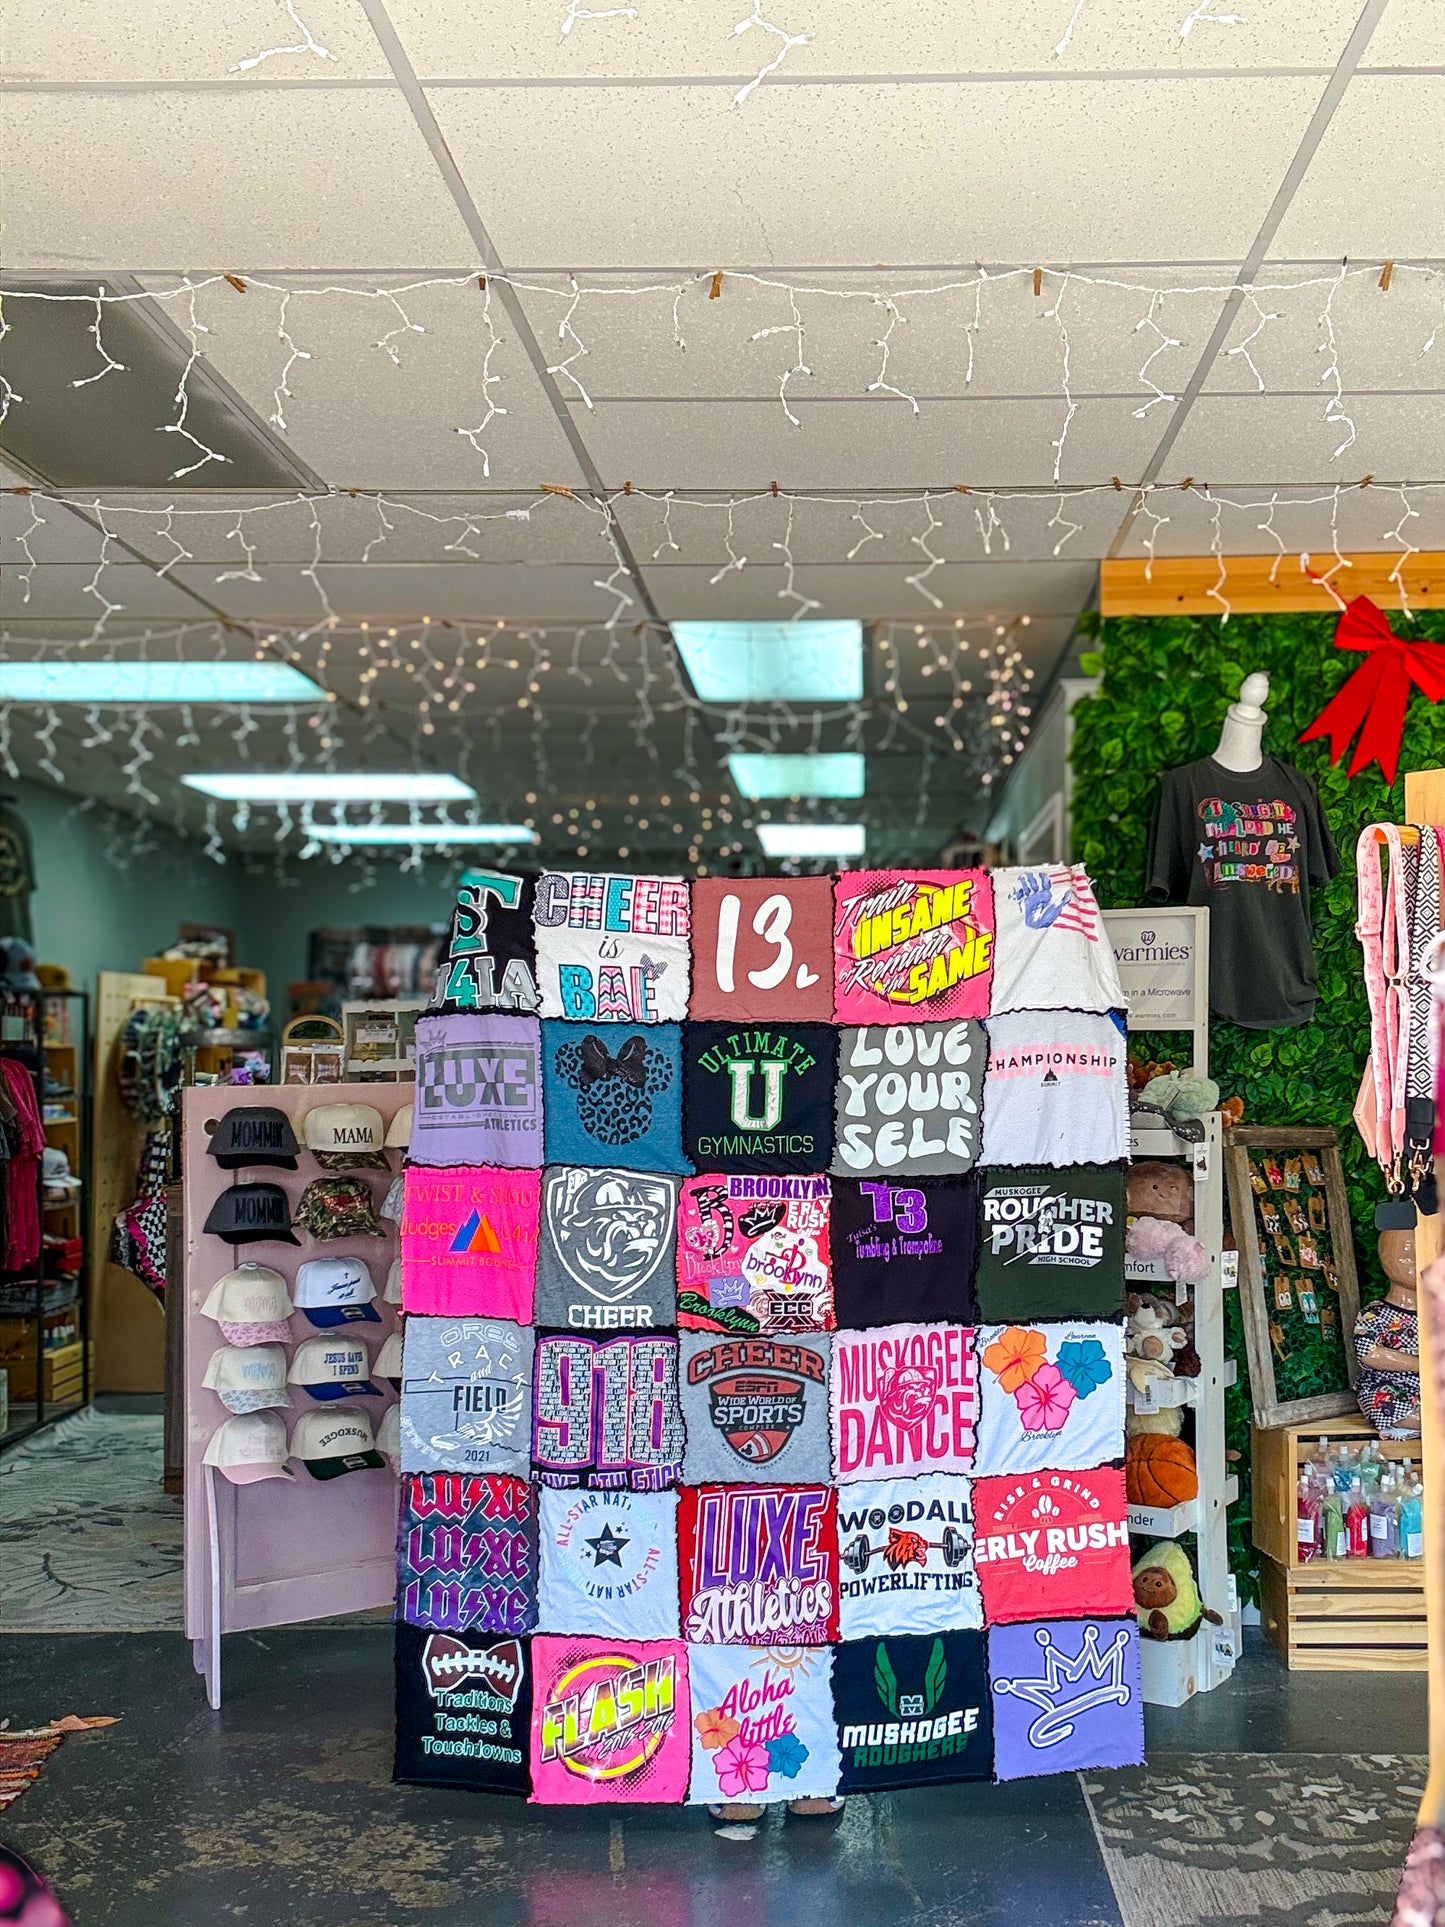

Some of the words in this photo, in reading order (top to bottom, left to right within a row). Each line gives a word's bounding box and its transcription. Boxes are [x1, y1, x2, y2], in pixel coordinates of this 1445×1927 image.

[1277, 823, 1294, 834] HE
[534, 874, 690, 936] CHEER
[835, 879, 917, 936] Train
[860, 879, 973, 959] INSANE
[598, 935, 624, 959] is
[844, 930, 952, 996] Remain
[909, 931, 993, 1004] SAME
[1148, 988, 1191, 997] Microwave
[697, 1031, 816, 1076] ULTIMATE
[850, 1022, 972, 1067] LOVE
[420, 1049, 534, 1108] LUXE
[727, 1059, 788, 1131] U
[841, 1071, 977, 1117] YOUR
[333, 1127, 373, 1144] MAMA
[484, 1117, 537, 1131] ATHLETICS
[698, 1135, 814, 1159] GYMNASTICS
[838, 1117, 973, 1170] SELF
[404, 1184, 464, 1202] TWIST
[994, 1187, 1042, 1196] MUSKOGEE
[983, 1196, 1114, 1225] ROUGHER
[400, 1217, 456, 1240] Judges
[991, 1223, 1104, 1257] PRIDE
[431, 1256, 479, 1267] SUMMIT
[892, 1237, 898, 1255] &
[1058, 1257, 1092, 1266] SCHOOL
[568, 1305, 654, 1328] CHEER
[428, 1344, 528, 1390] TRACK
[687, 1340, 825, 1386] CHEER
[839, 1329, 974, 1405] MUSKOGEE
[453, 1385, 507, 1413] FIELD
[535, 1335, 681, 1470] 918
[717, 1396, 747, 1406] WIDE
[747, 1396, 784, 1405] WORLD
[735, 1381, 779, 1392] ESPN
[713, 1404, 803, 1425] SPORTS
[319, 1426, 368, 1448] MUSKOGEE
[839, 1392, 975, 1472] DANCE
[464, 1450, 490, 1462] 2021
[993, 1488, 1026, 1522] RISE
[1032, 1477, 1042, 1488] &
[1050, 1475, 1101, 1509] GRIND
[839, 1499, 974, 1533] WOODALL
[698, 1489, 828, 1589] LUXE
[974, 1529, 1041, 1563] ERLY
[1046, 1520, 1129, 1554] RUSH
[1022, 1553, 1079, 1576] Coffee
[840, 1570, 973, 1600] POWERLIFTING
[685, 1576, 832, 1643] Athletics
[435, 1688, 514, 1715] Traditions
[541, 1655, 676, 1763] FLASH
[717, 1669, 796, 1720] Aloha
[435, 1714, 498, 1736] Tackles
[500, 1719, 511, 1738] &
[598, 1713, 674, 1760] 2015-2016
[738, 1703, 797, 1749] little
[842, 1707, 980, 1748] MUSKOGEE
[421, 1736, 522, 1764] Touchdowns
